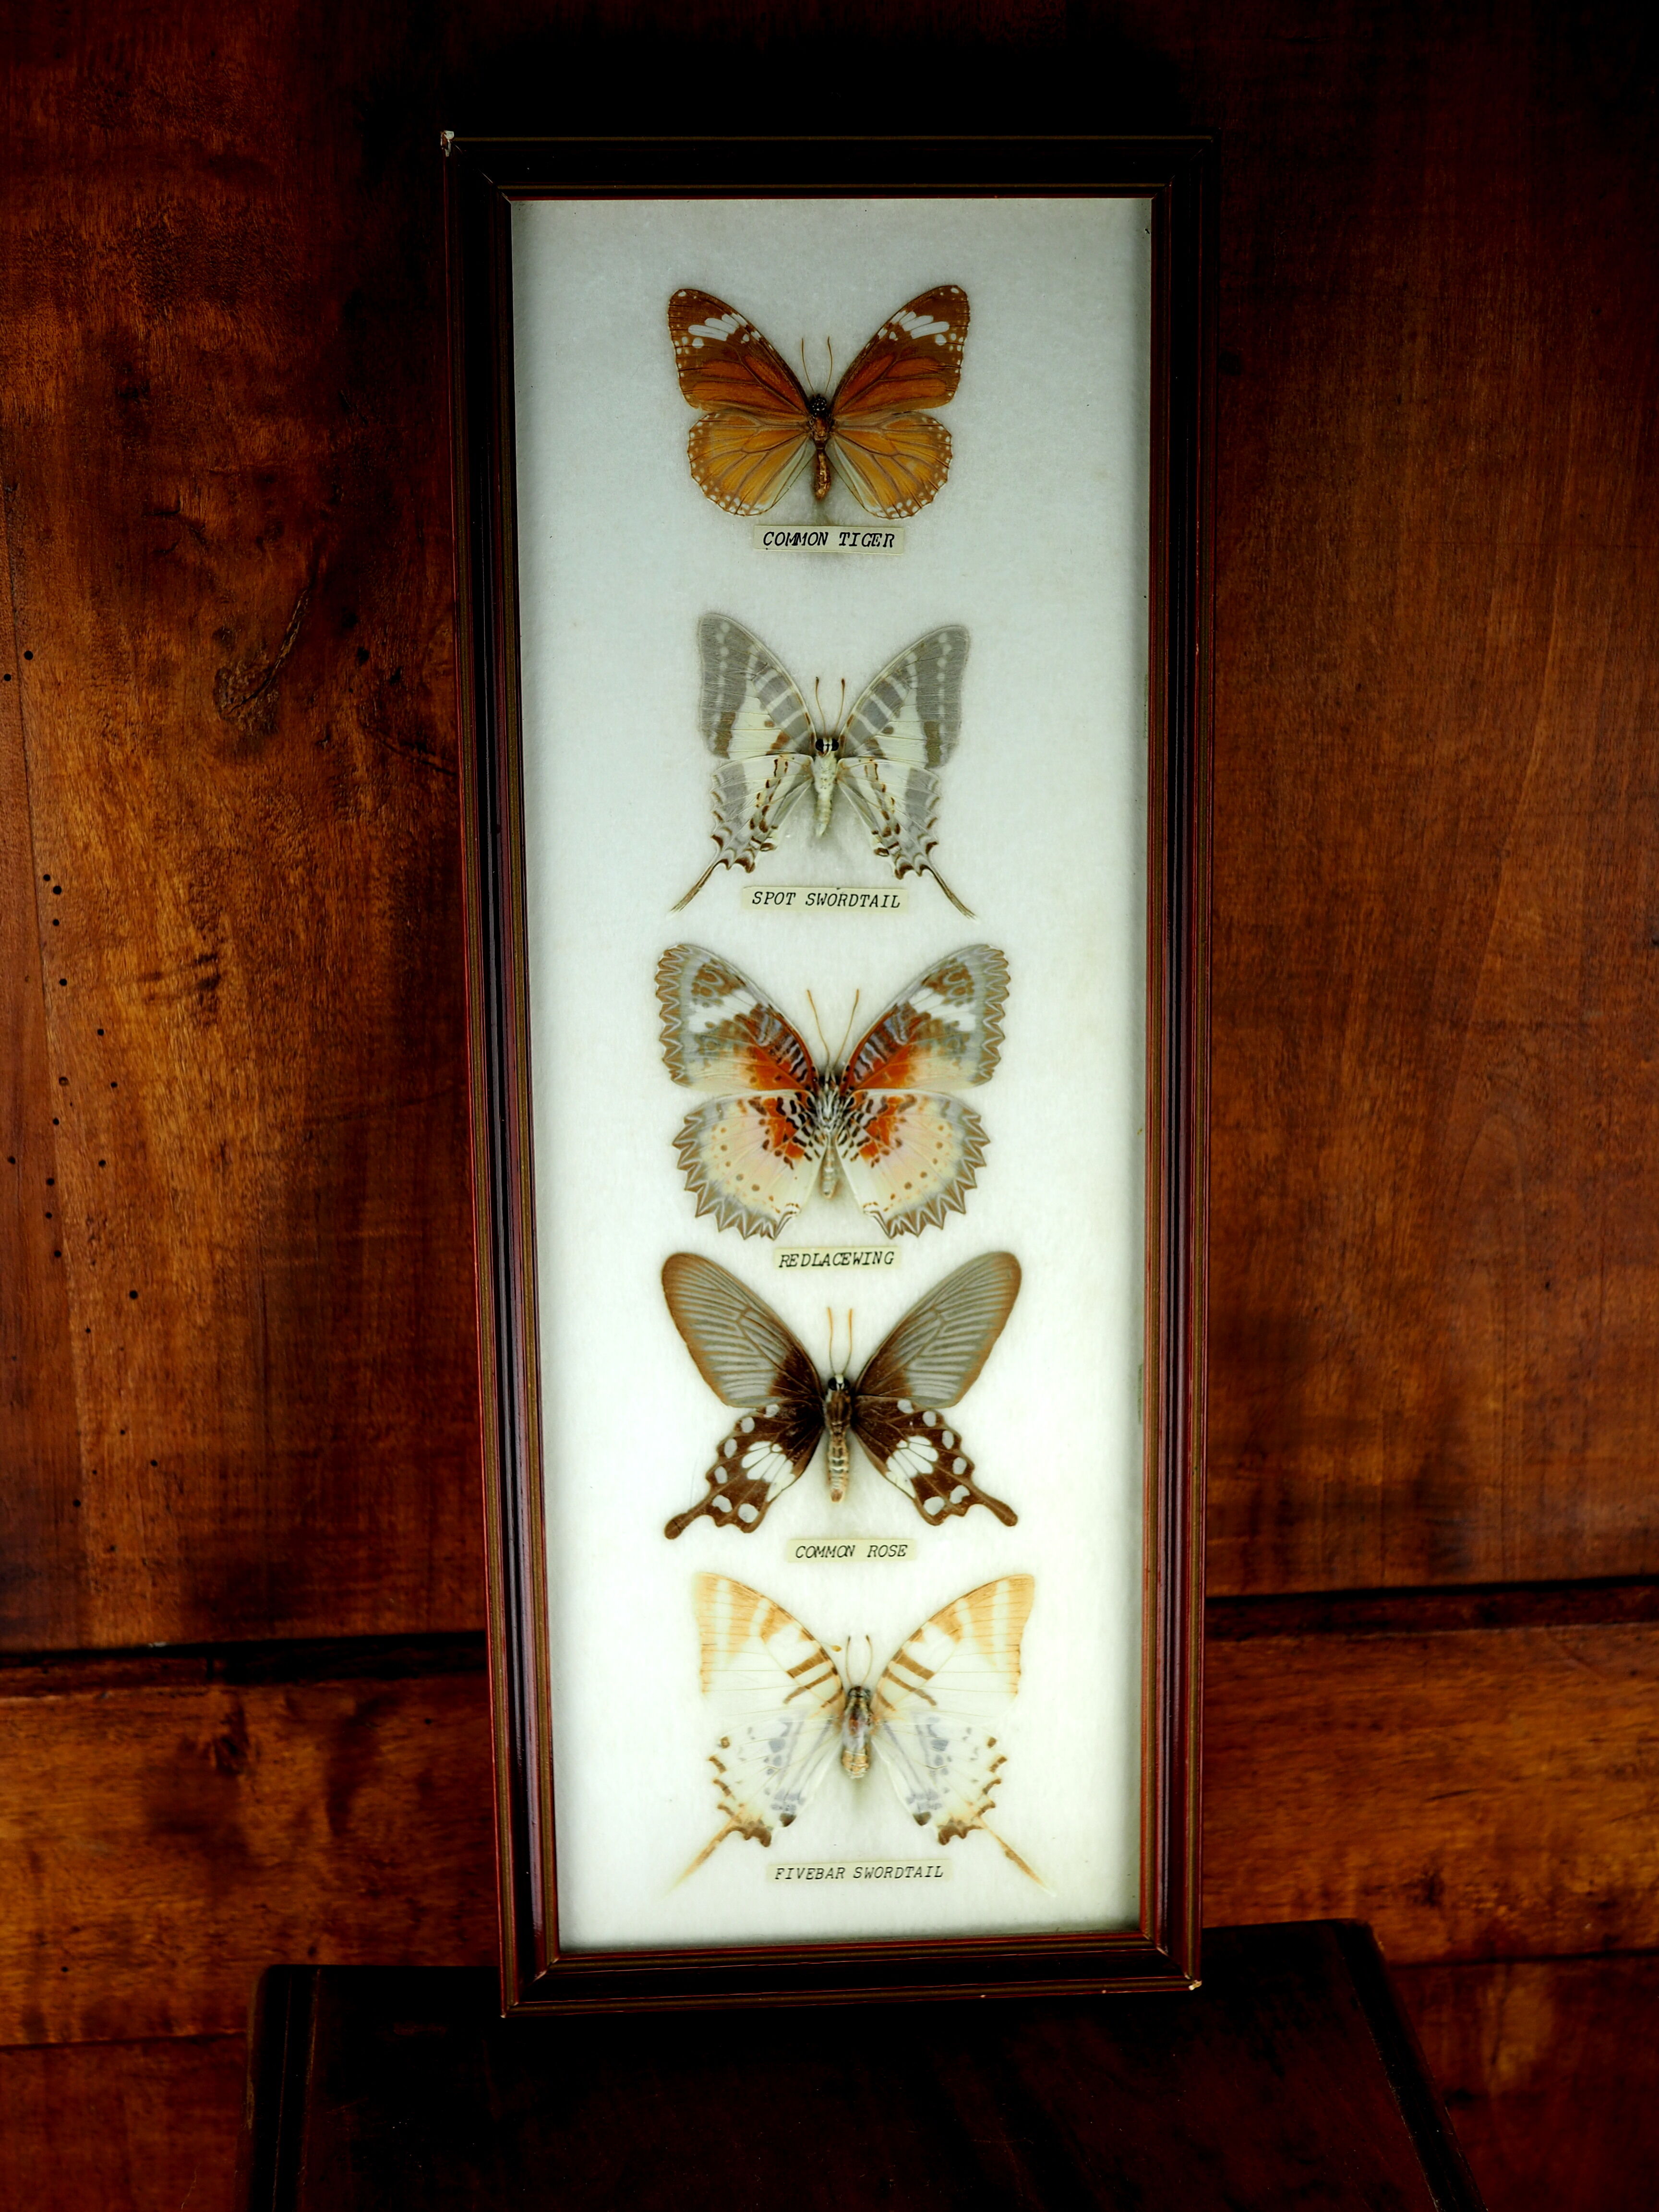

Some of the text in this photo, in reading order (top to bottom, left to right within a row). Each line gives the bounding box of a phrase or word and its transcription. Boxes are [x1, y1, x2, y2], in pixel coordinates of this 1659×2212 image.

[763, 531, 895, 548] COMMON TIGER
[752, 891, 901, 908] SPOT SWORDTAIL
[779, 1250, 895, 1268] REDLACEWING
[795, 1544, 908, 1558] COMMON ROSE
[775, 1865, 944, 1880] FIVEBAR SWORDTAIL
